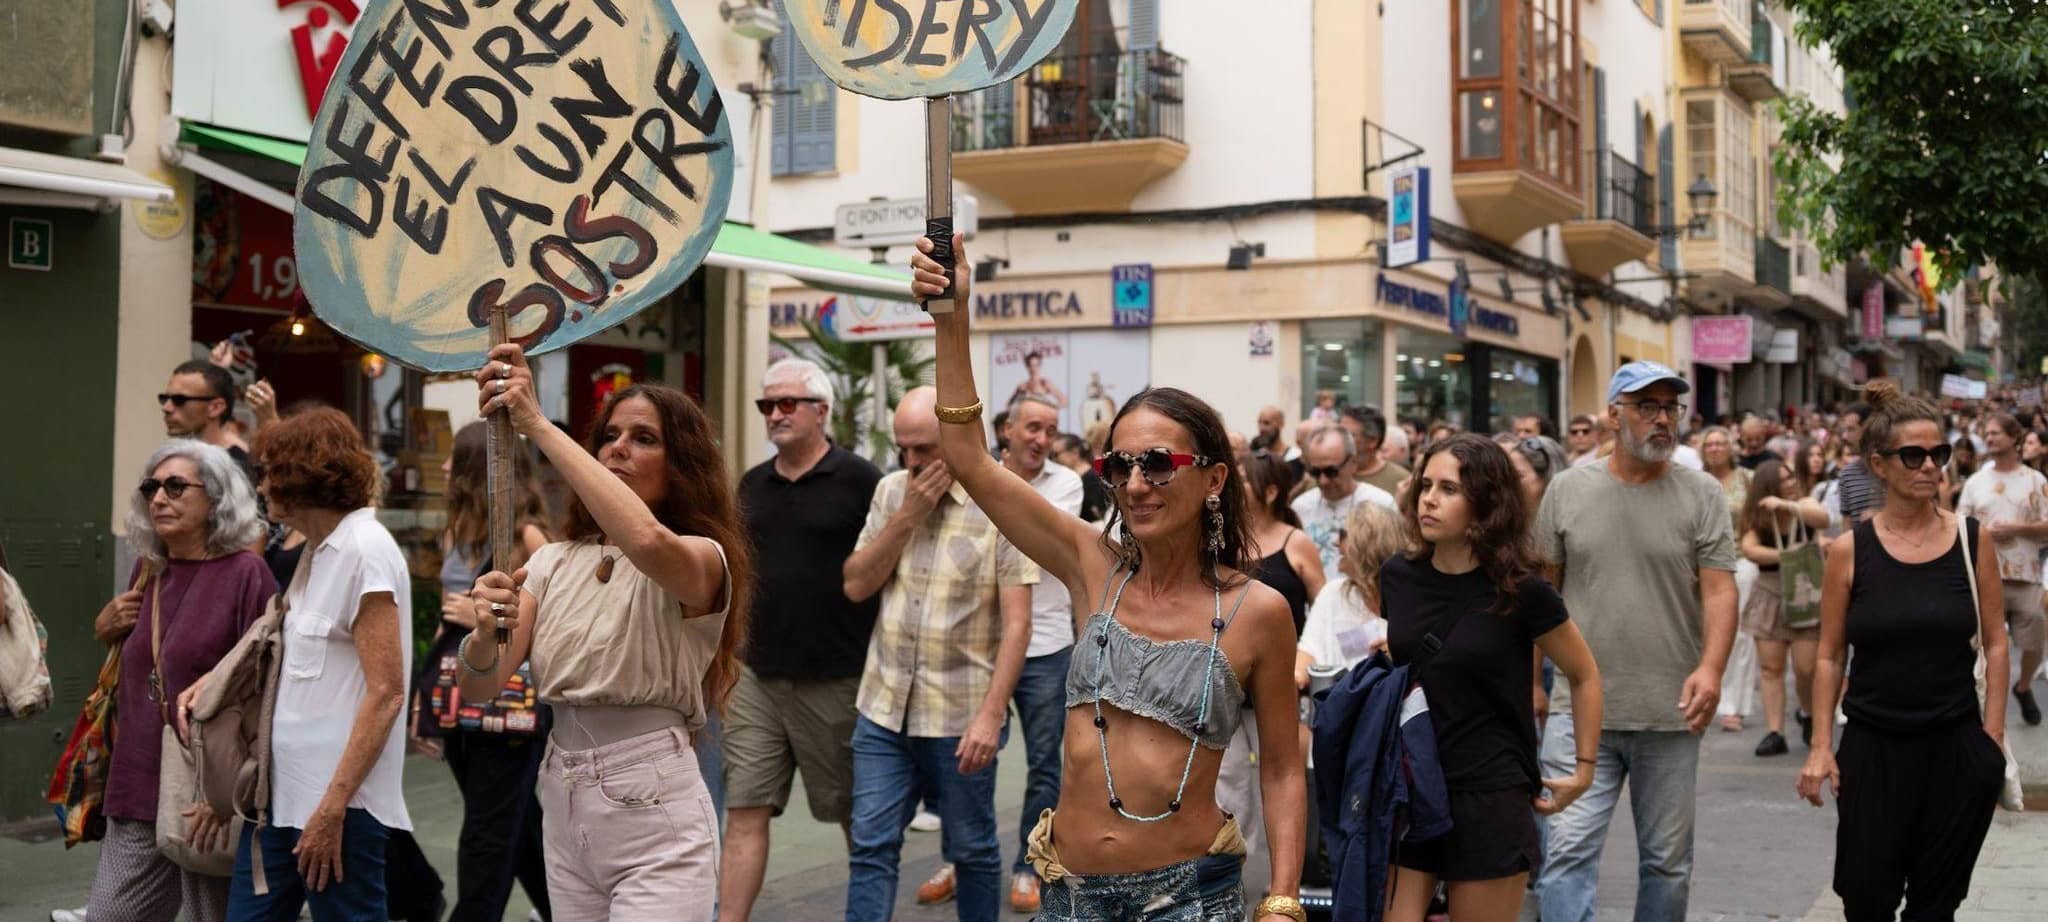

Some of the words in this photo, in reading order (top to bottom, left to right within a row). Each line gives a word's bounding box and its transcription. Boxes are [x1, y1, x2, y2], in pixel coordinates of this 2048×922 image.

[823, 0, 1054, 80] ISERY
[302, 0, 500, 238] DEFEN
[513, 56, 637, 184] UN
[393, 146, 478, 255] EL
[860, 207, 889, 225] FONT
[22, 229, 40, 257] B
[476, 186, 554, 268] A
[249, 253, 297, 300] 1,9
[1117, 266, 1148, 281] TIN
[975, 289, 1083, 320] METICA
[1117, 309, 1149, 326] TIN
